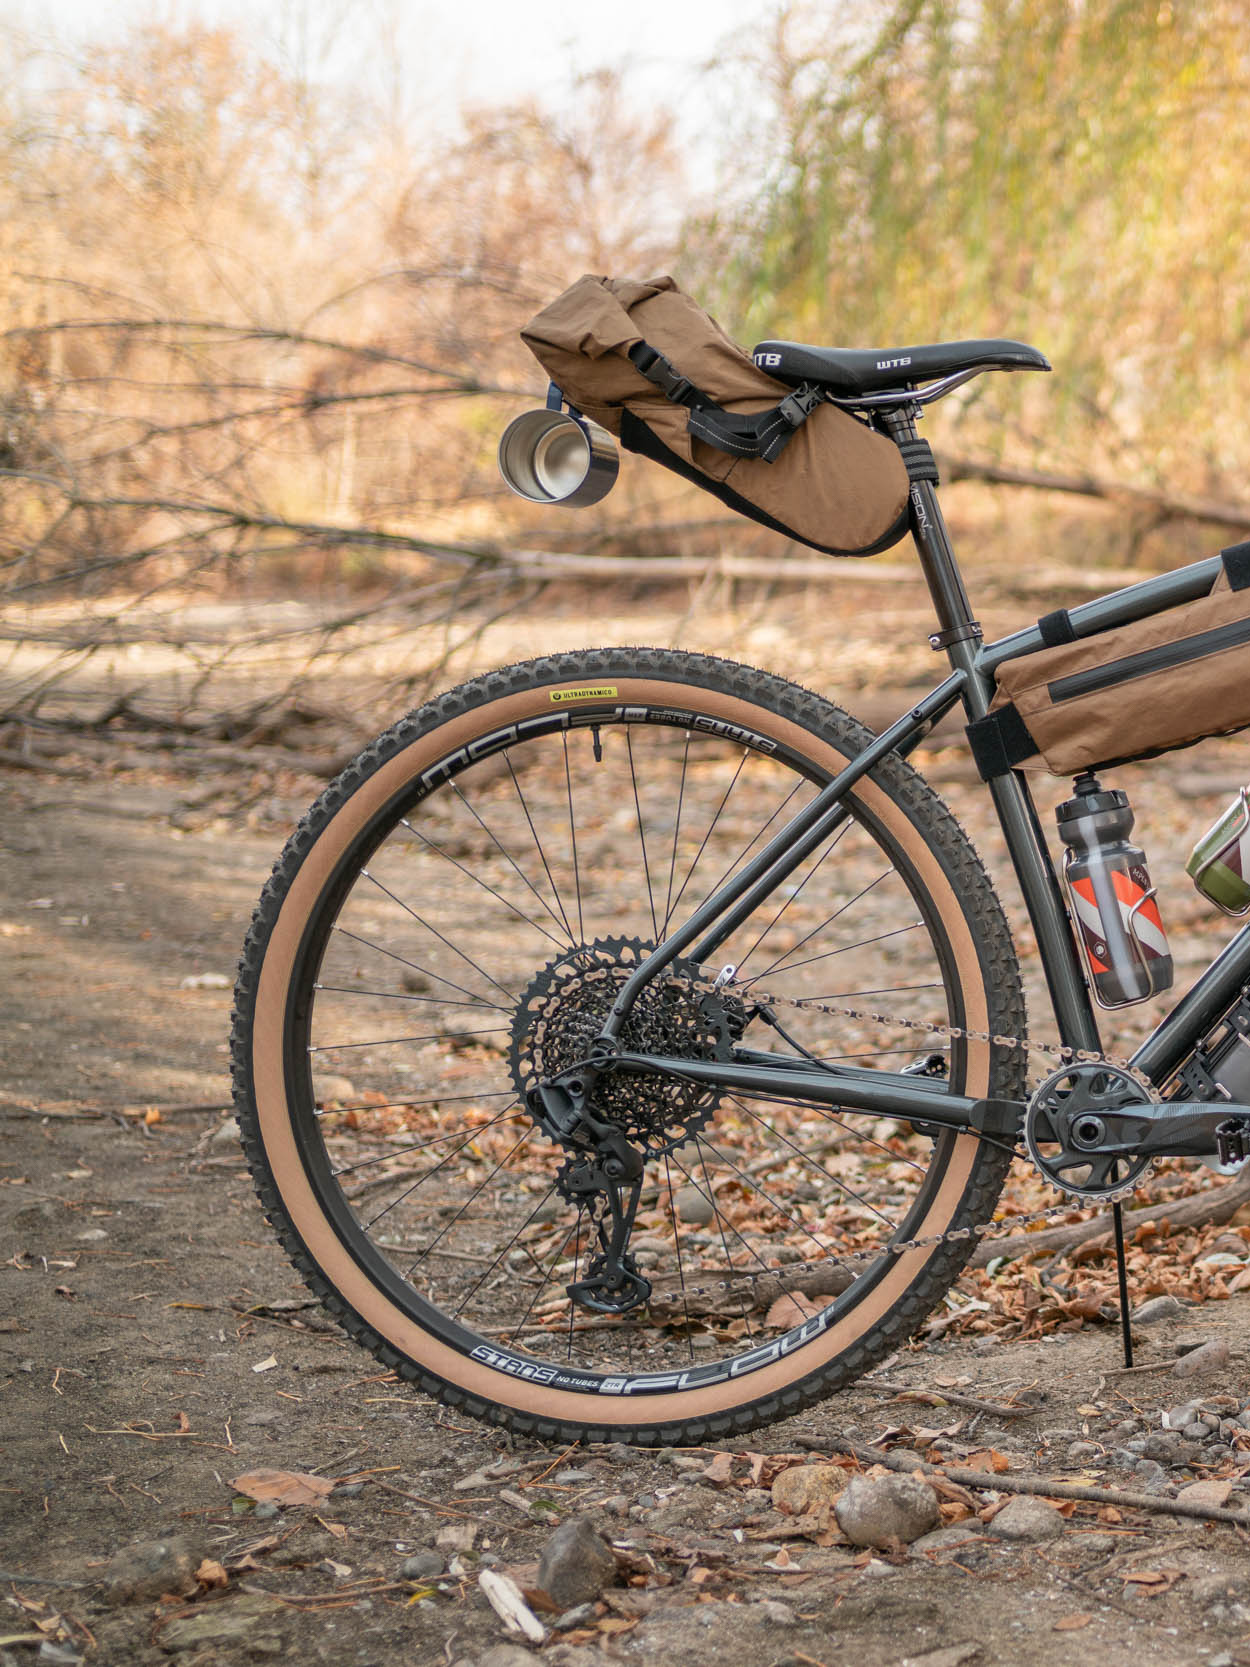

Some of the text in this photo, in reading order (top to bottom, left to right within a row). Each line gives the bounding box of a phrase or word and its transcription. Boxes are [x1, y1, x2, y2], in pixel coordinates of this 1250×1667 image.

[876, 356, 912, 370] WTB
[563, 689, 612, 699] ULTRADYNAMICO
[693, 715, 778, 753] STANS
[470, 1345, 559, 1384] STANS
[556, 1375, 569, 1383] NO
[570, 1377, 600, 1388] TUBES
[623, 1312, 828, 1394] FLOW
